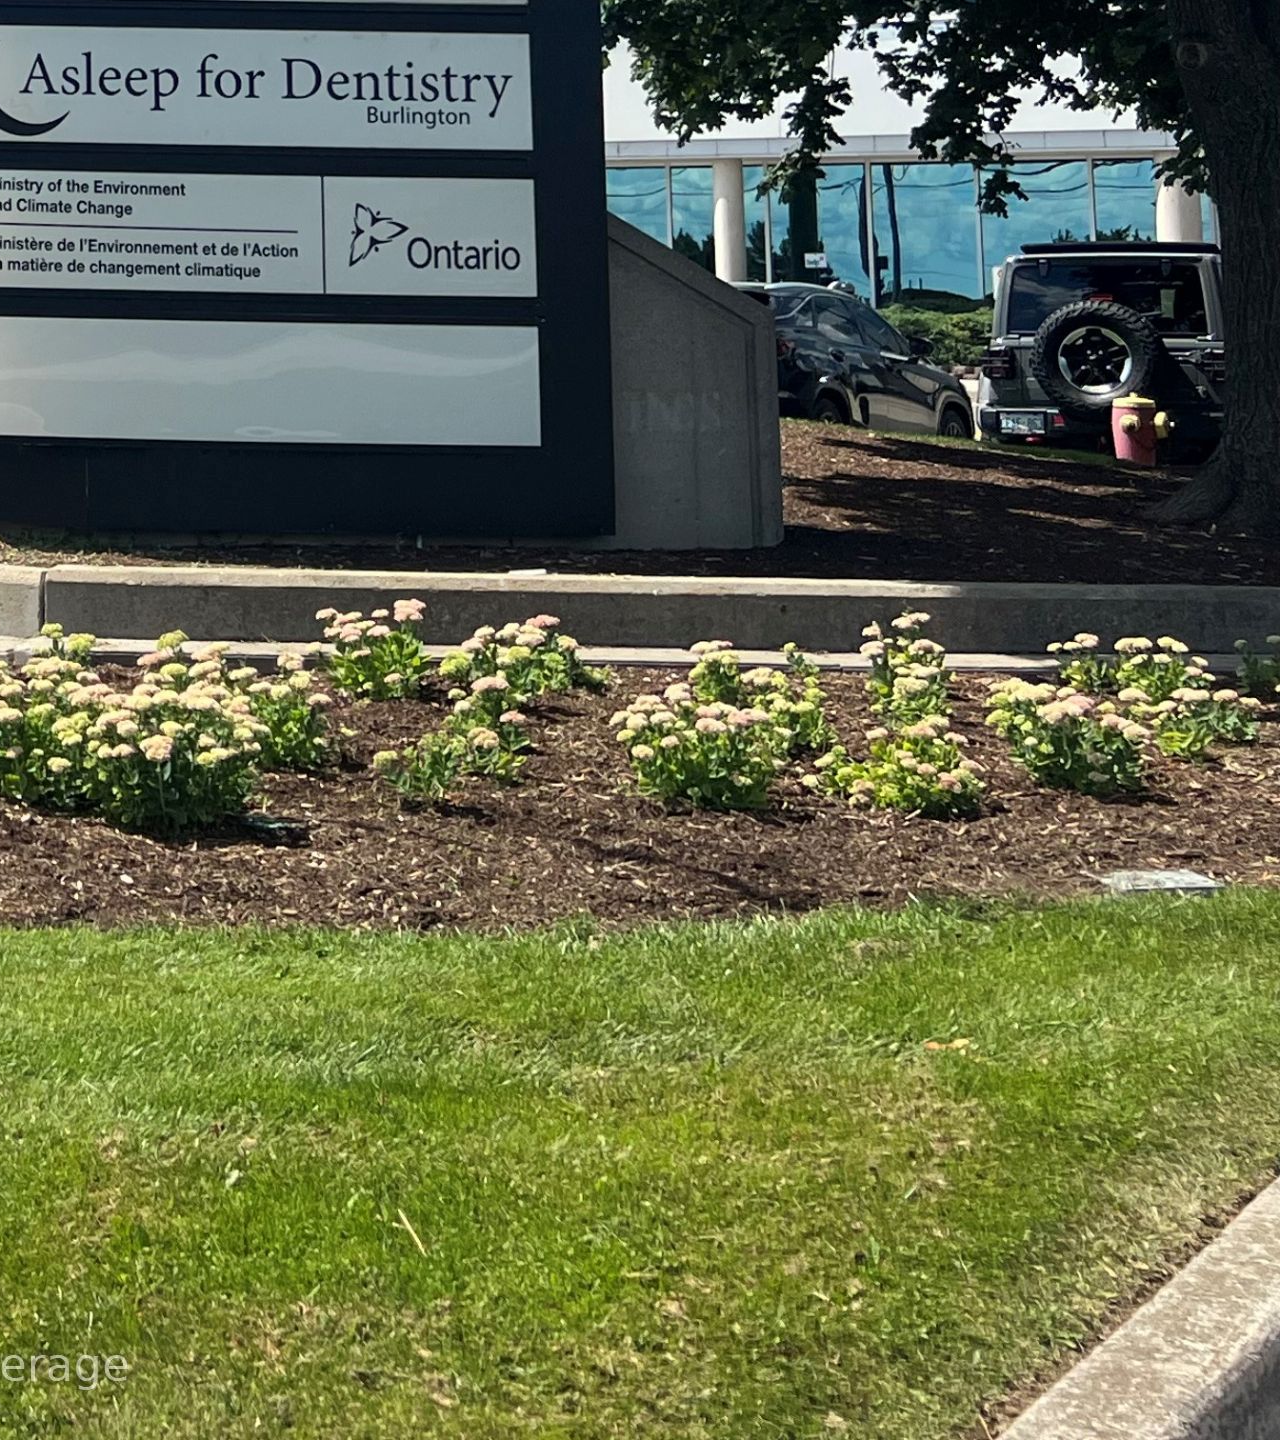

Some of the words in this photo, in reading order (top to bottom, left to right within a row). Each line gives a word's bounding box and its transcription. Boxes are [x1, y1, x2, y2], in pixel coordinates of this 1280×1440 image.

[18, 51, 180, 111] Asleep
[196, 54, 266, 100] for
[281, 58, 513, 118] Dentistry
[366, 106, 471, 129] Burlington
[48, 178, 63, 192] of
[67, 180, 89, 193] the
[94, 180, 186, 196] Environment
[16, 199, 72, 214] Climate
[77, 200, 133, 218] Change
[57, 238, 75, 252] de
[80, 238, 198, 256] l'Environnement
[202, 244, 217, 256] et
[221, 242, 239, 256] de
[244, 243, 298, 258] l'Action
[407, 237, 521, 271] Ontario
[7, 258, 63, 272] matière
[67, 259, 85, 273] de
[89, 260, 181, 277] changement
[185, 262, 261, 280] climatique
